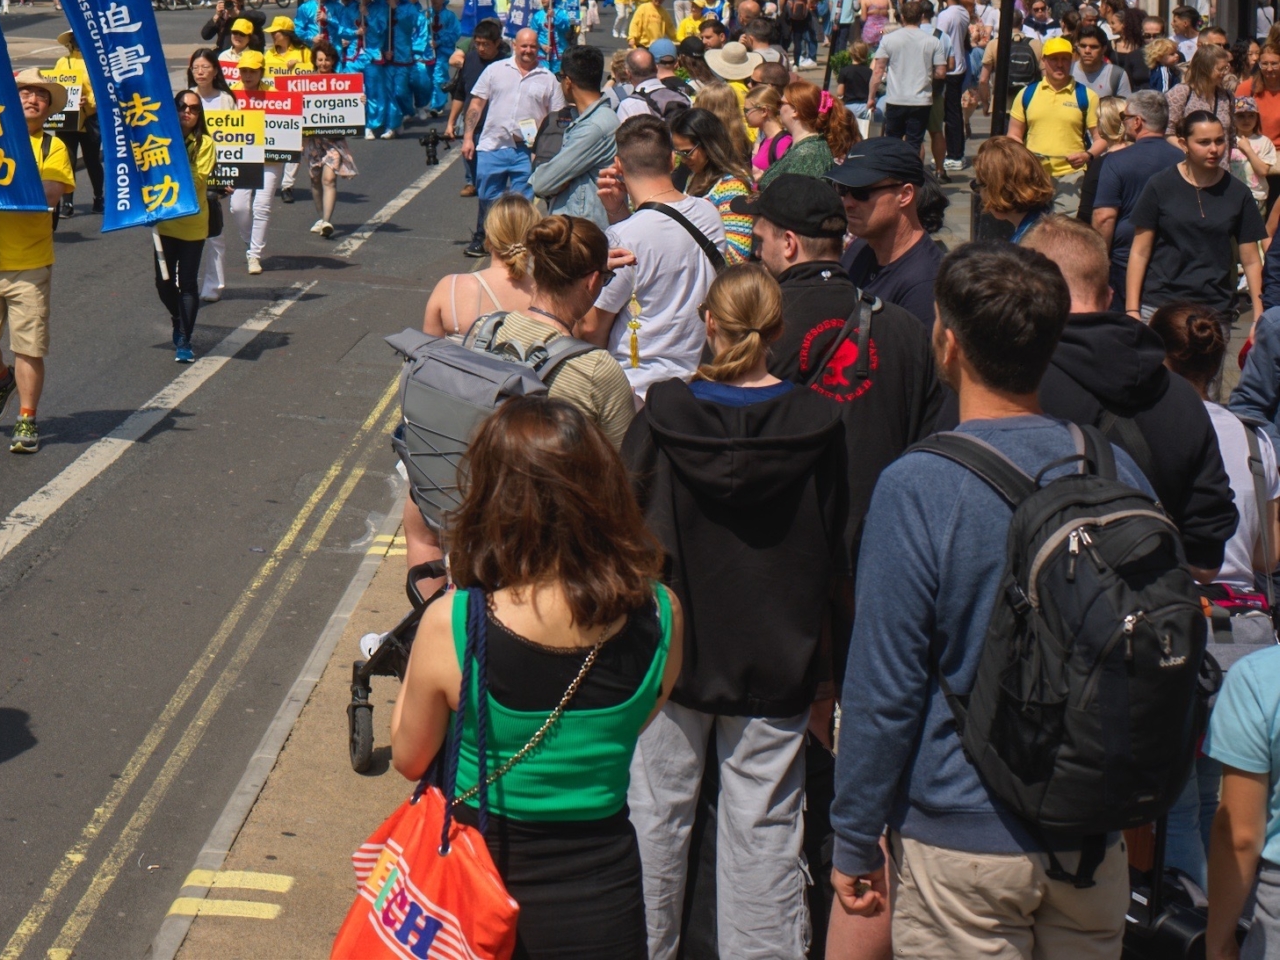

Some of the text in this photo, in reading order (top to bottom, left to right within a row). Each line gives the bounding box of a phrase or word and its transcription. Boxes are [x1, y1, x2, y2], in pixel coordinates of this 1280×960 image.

[221, 65, 240, 79] org
[269, 66, 292, 75] Falun
[60, 74, 77, 83] Gong
[287, 78, 327, 93] Killed
[329, 77, 351, 91] for
[70, 86, 80, 96] for
[106, 81, 118, 103] OF
[249, 97, 292, 110] forced
[314, 96, 359, 110] organs
[206, 114, 245, 127] ceful
[310, 113, 346, 125] China
[113, 108, 128, 159] FALUN
[212, 130, 256, 146] Gong
[302, 128, 357, 137] rganHarvesting.org
[116, 162, 131, 211] GONG
